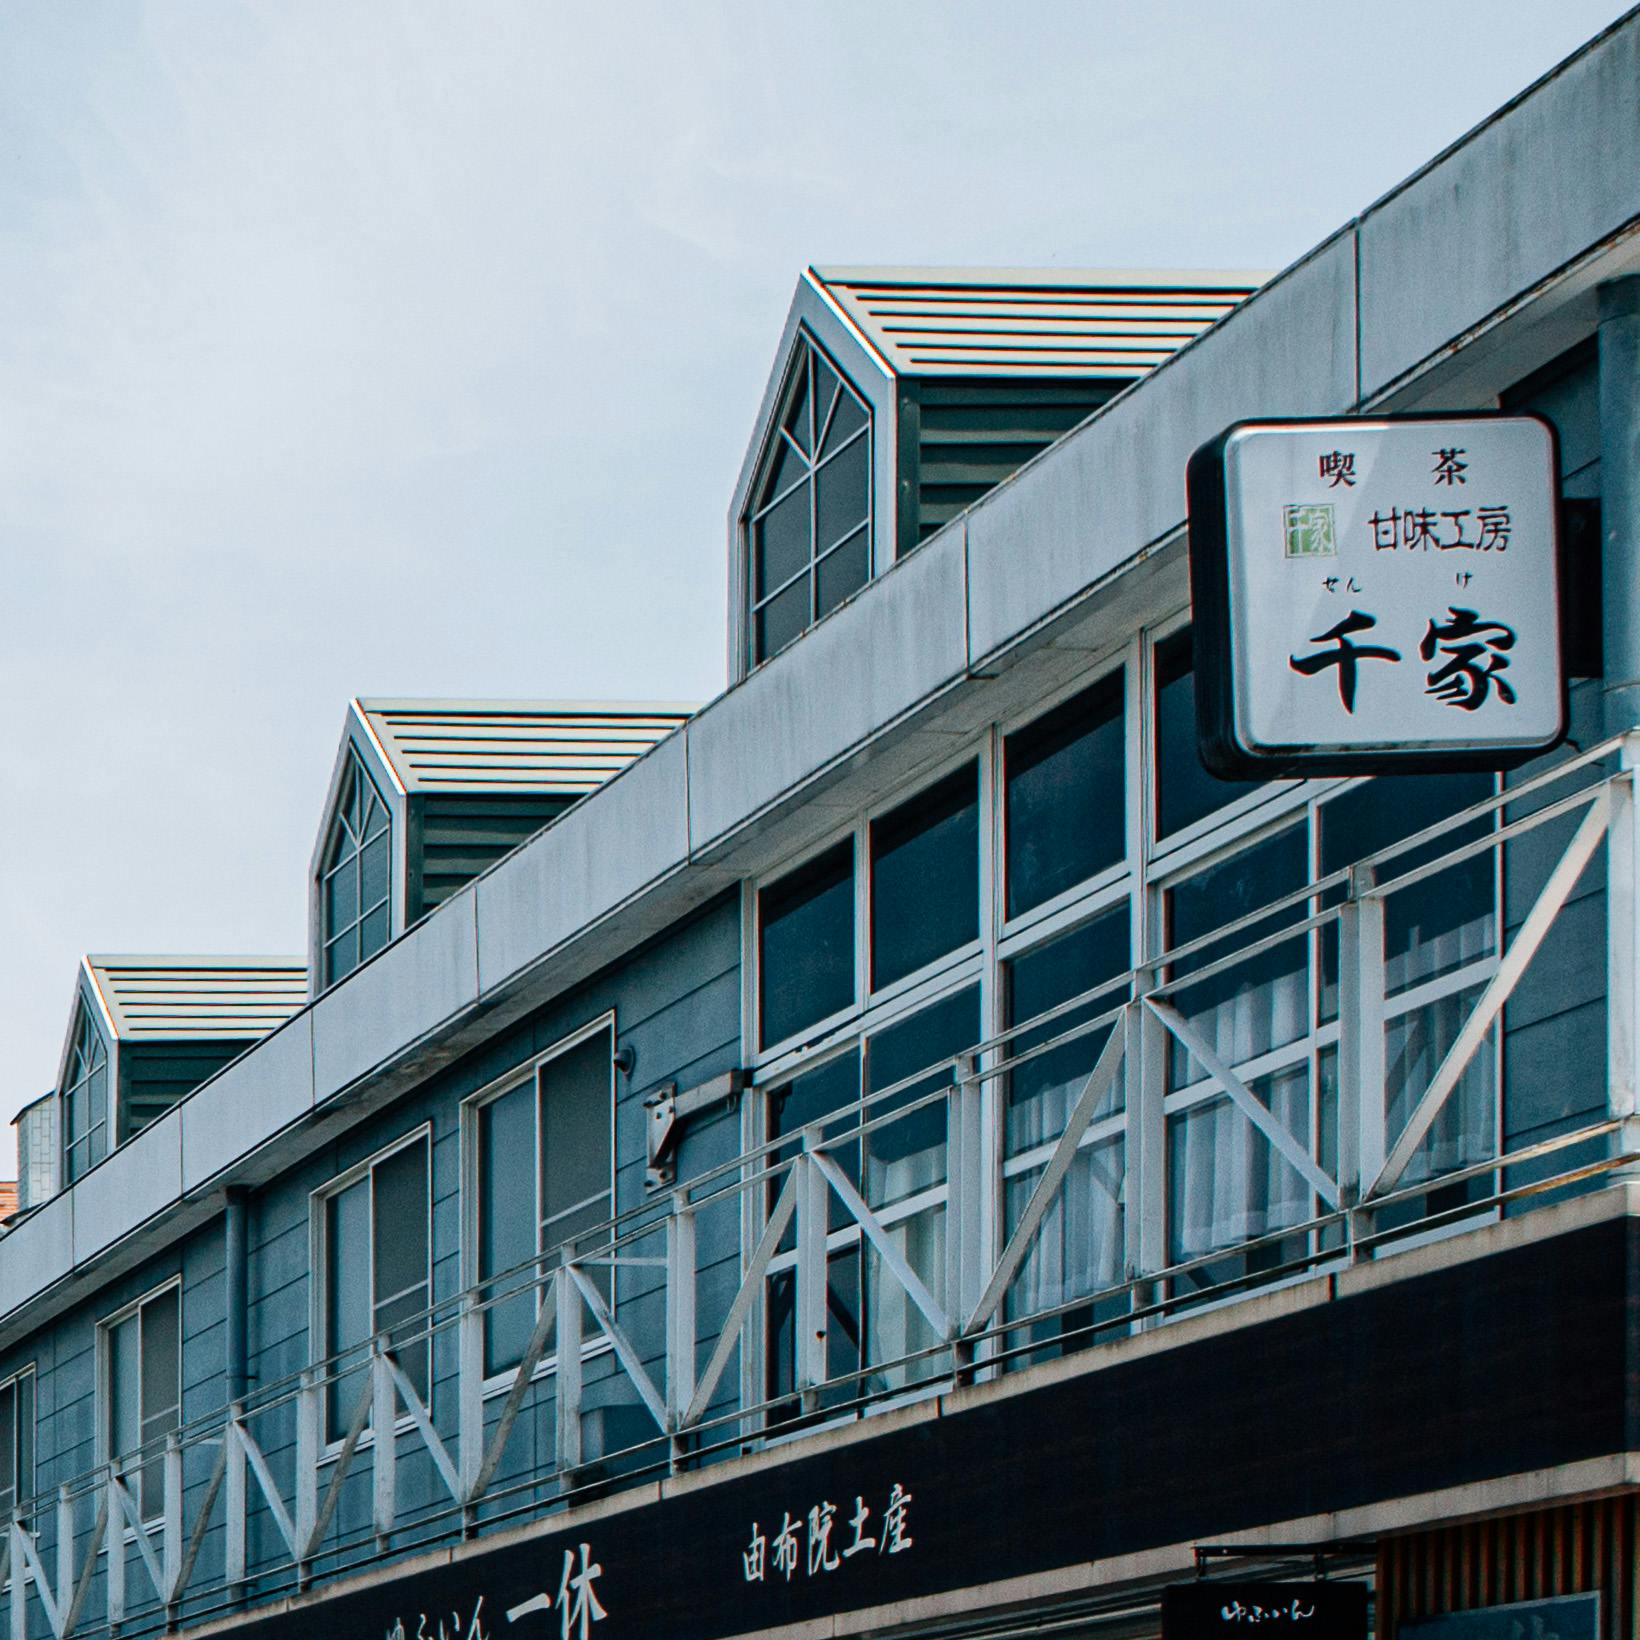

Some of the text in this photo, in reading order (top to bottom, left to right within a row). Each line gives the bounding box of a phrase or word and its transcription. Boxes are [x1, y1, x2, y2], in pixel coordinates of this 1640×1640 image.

[1319, 447, 1468, 488] 喫茶
[1368, 505, 1512, 552] 甘味工房
[1289, 605, 1519, 716] 千家
[741, 1483, 914, 1583] 由布院土産
